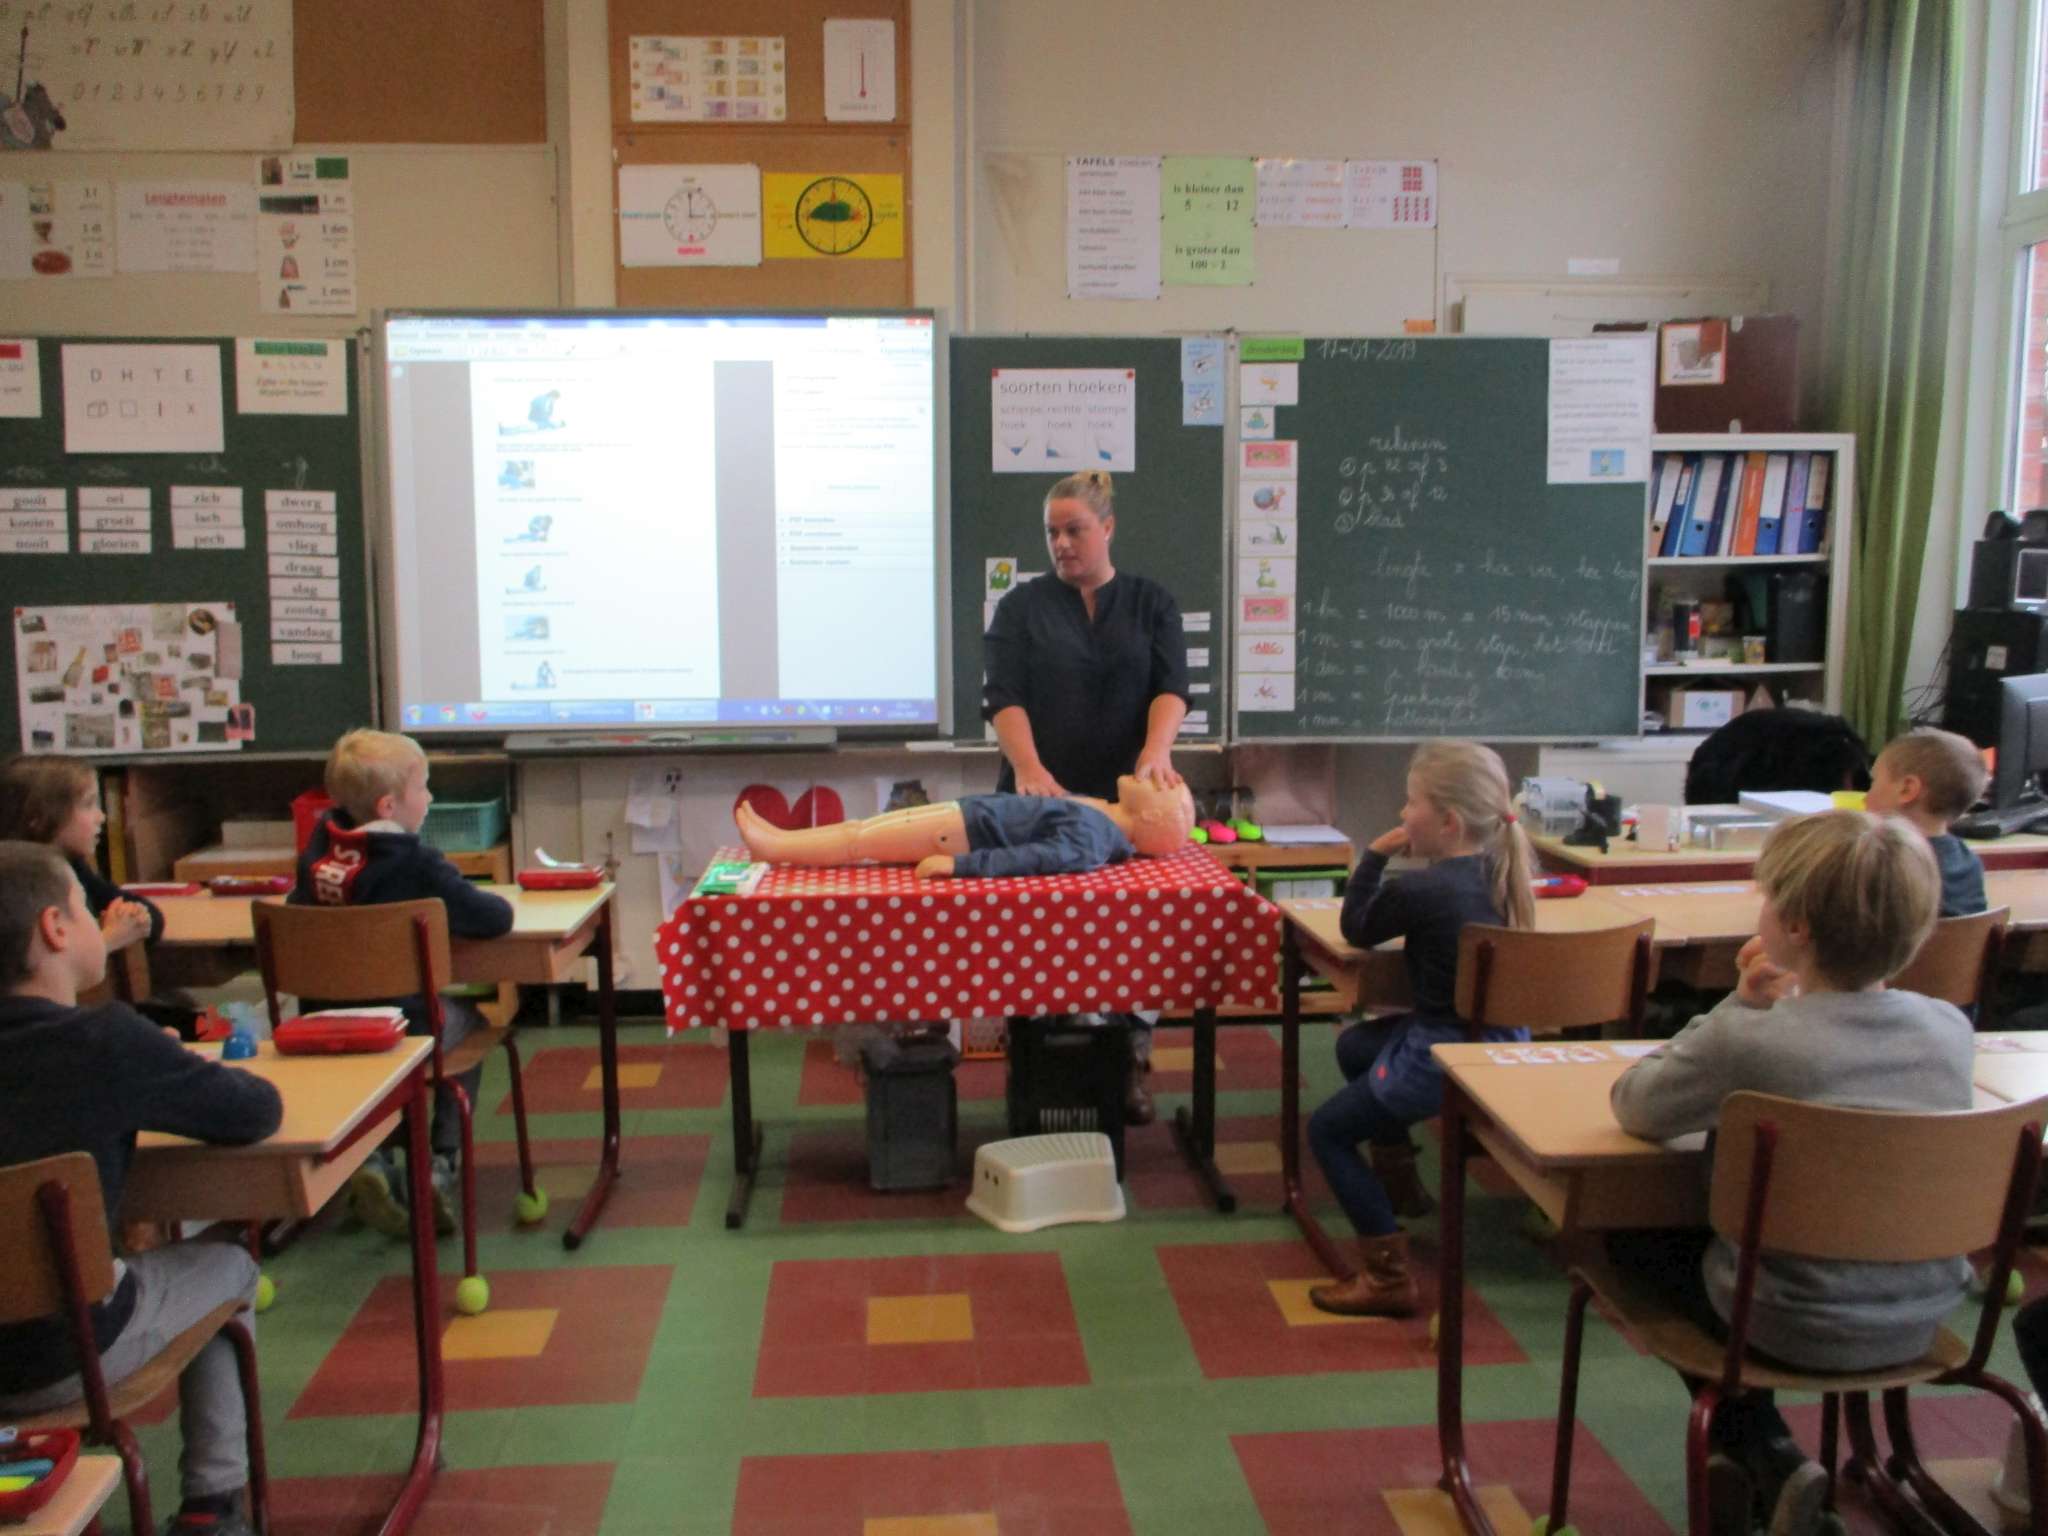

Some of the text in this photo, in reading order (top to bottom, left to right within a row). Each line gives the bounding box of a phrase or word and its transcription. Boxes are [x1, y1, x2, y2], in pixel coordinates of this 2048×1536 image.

[1185, 183, 1221, 194] kleiner
[1224, 183, 1244, 194] dan
[1186, 246, 1217, 257] groter
[1221, 245, 1240, 256] dan
[90, 368, 195, 382] D H T E
[1000, 379, 1127, 394] soorten hoeken
[1047, 420, 1072, 430] hoek
[193, 492, 220, 504] zich
[281, 497, 322, 509] dwerg
